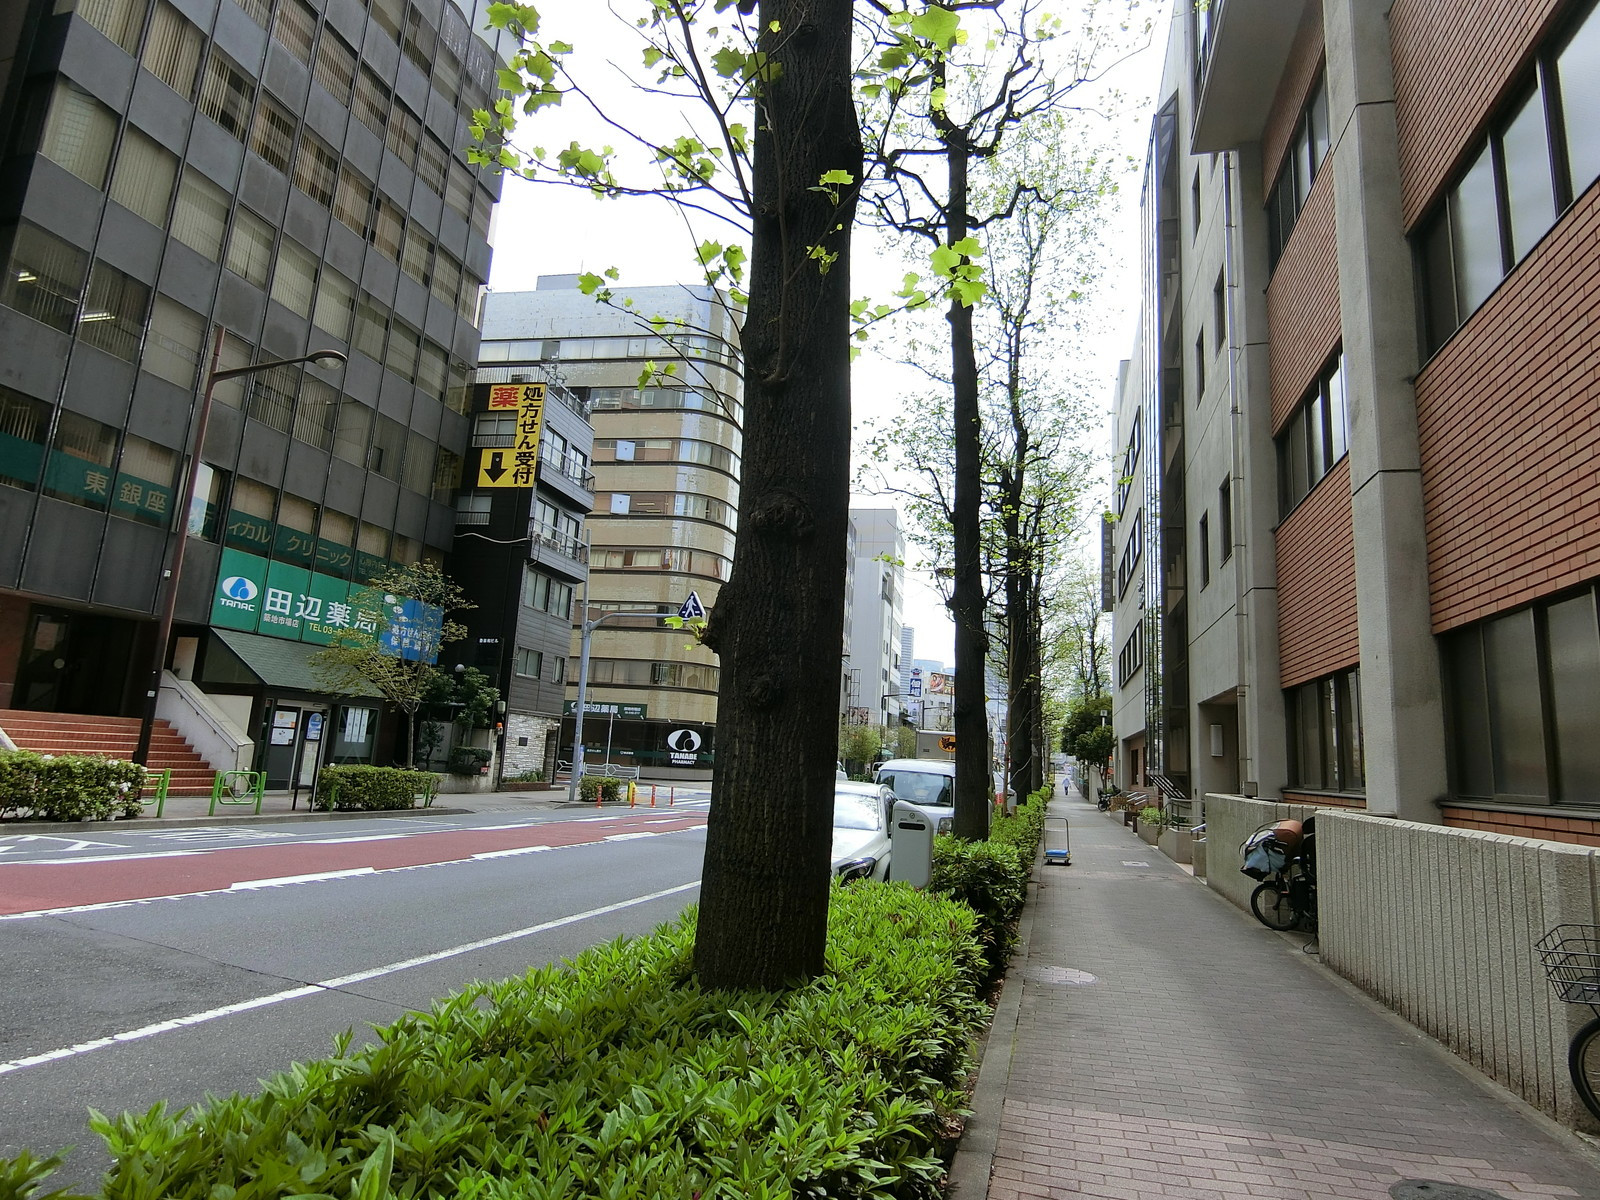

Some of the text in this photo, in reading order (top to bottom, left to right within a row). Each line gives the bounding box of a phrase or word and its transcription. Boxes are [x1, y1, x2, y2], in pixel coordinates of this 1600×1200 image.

[492, 387, 519, 407] 薬
[512, 386, 543, 485] 処方せん受付
[84, 470, 168, 513] 東銀座
[287, 535, 351, 567] クリニック
[220, 598, 256, 612] TANAC
[265, 587, 377, 633] 田辺薬局
[309, 622, 322, 633] TEL
[670, 752, 698, 760] TANABE
